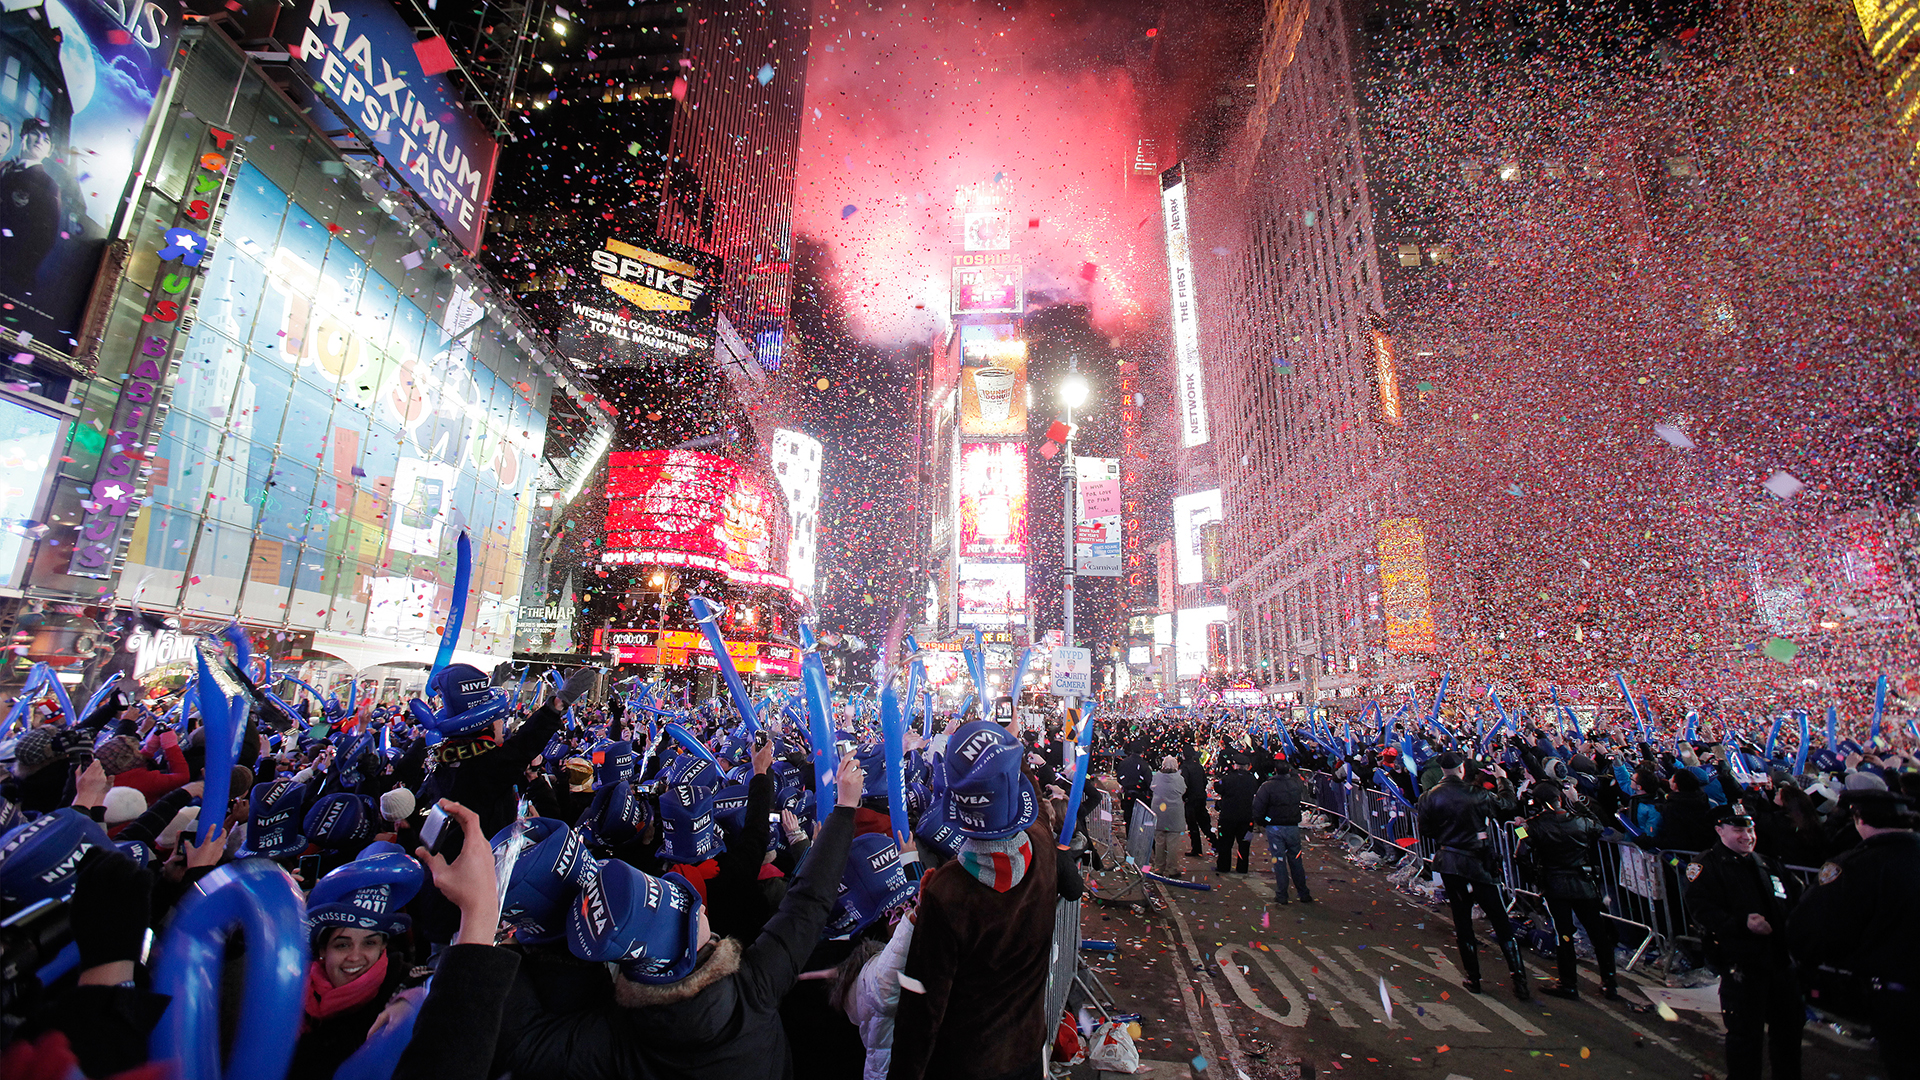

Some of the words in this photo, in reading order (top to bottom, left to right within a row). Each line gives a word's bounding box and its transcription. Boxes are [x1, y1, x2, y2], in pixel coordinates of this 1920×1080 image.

[301, 27, 391, 132] PEPSI
[309, 0, 482, 202] MAXIMUM
[186, 127, 235, 220] TOYS
[399, 128, 475, 232] TASTE
[591, 249, 705, 300] SPIKE
[953, 254, 1022, 265] TOSHIBA
[153, 273, 191, 322] US
[1176, 267, 1187, 298] FIRST
[572, 303, 627, 328] WISHING
[628, 319, 665, 338] GOOD
[664, 330, 709, 349] THINGS
[1178, 301, 1189, 323] THE
[589, 320, 607, 334] TO
[607, 324, 630, 341] ALL
[107, 336, 169, 476] BABIES
[1122, 379, 1133, 456] ERNST
[1186, 373, 1200, 434] NETWORK
[1126, 472, 1135, 483] &
[80, 520, 117, 568] US
[1127, 500, 1141, 586] YOUNG
[1088, 564, 1119, 572] Carnival
[545, 606, 576, 620] MAP
[918, 642, 962, 651] TOSHIBA
[1060, 650, 1084, 660] NYPD
[1056, 679, 1086, 689] CAMERA
[266, 781, 289, 806] NIVEA
[1021, 791, 1033, 819] KISSED
[257, 811, 290, 826] NIVEA
[317, 801, 344, 836] NIVEA
[693, 814, 711, 831] NIVEA
[258, 836, 283, 848] 2011
[42, 843, 94, 883] NIVEA
[318, 911, 356, 923] KISSED
[587, 875, 608, 935] NIVEA
